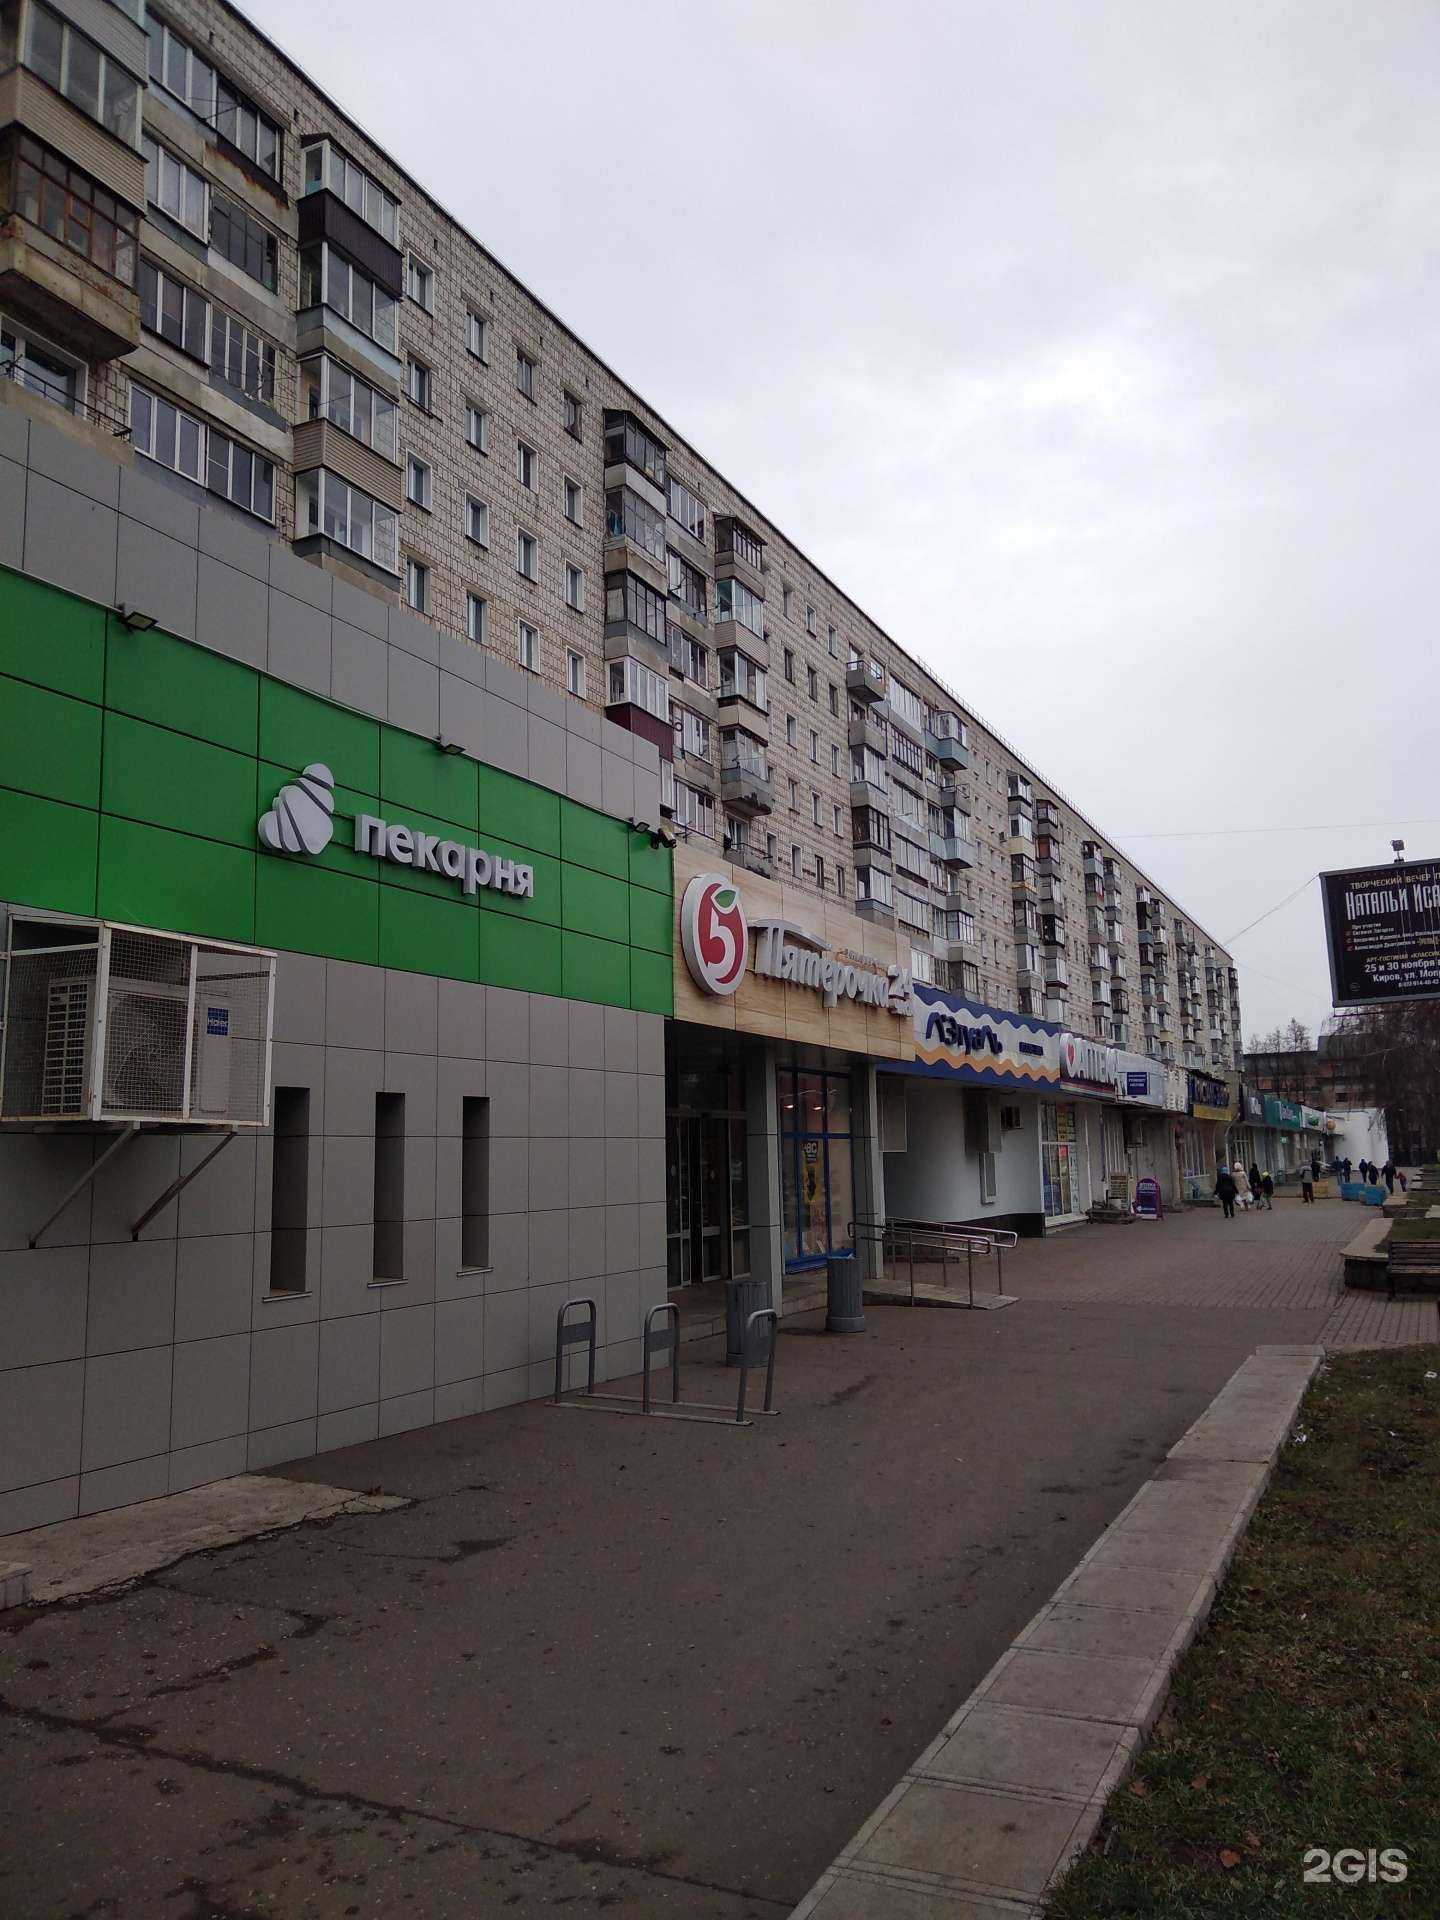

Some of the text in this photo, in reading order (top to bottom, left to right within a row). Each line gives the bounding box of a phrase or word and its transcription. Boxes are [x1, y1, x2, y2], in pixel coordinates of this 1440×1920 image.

[354, 814, 534, 898] пекарня
[1351, 878, 1402, 890] ТВОРЧЕСКИЙ
[1406, 874, 1431, 883] ВЕЧЕР
[748, 919, 888, 1008] Пятерочка
[1365, 964, 1377, 973] 25
[1387, 961, 1399, 970] 30
[1401, 959, 1435, 969] ноября
